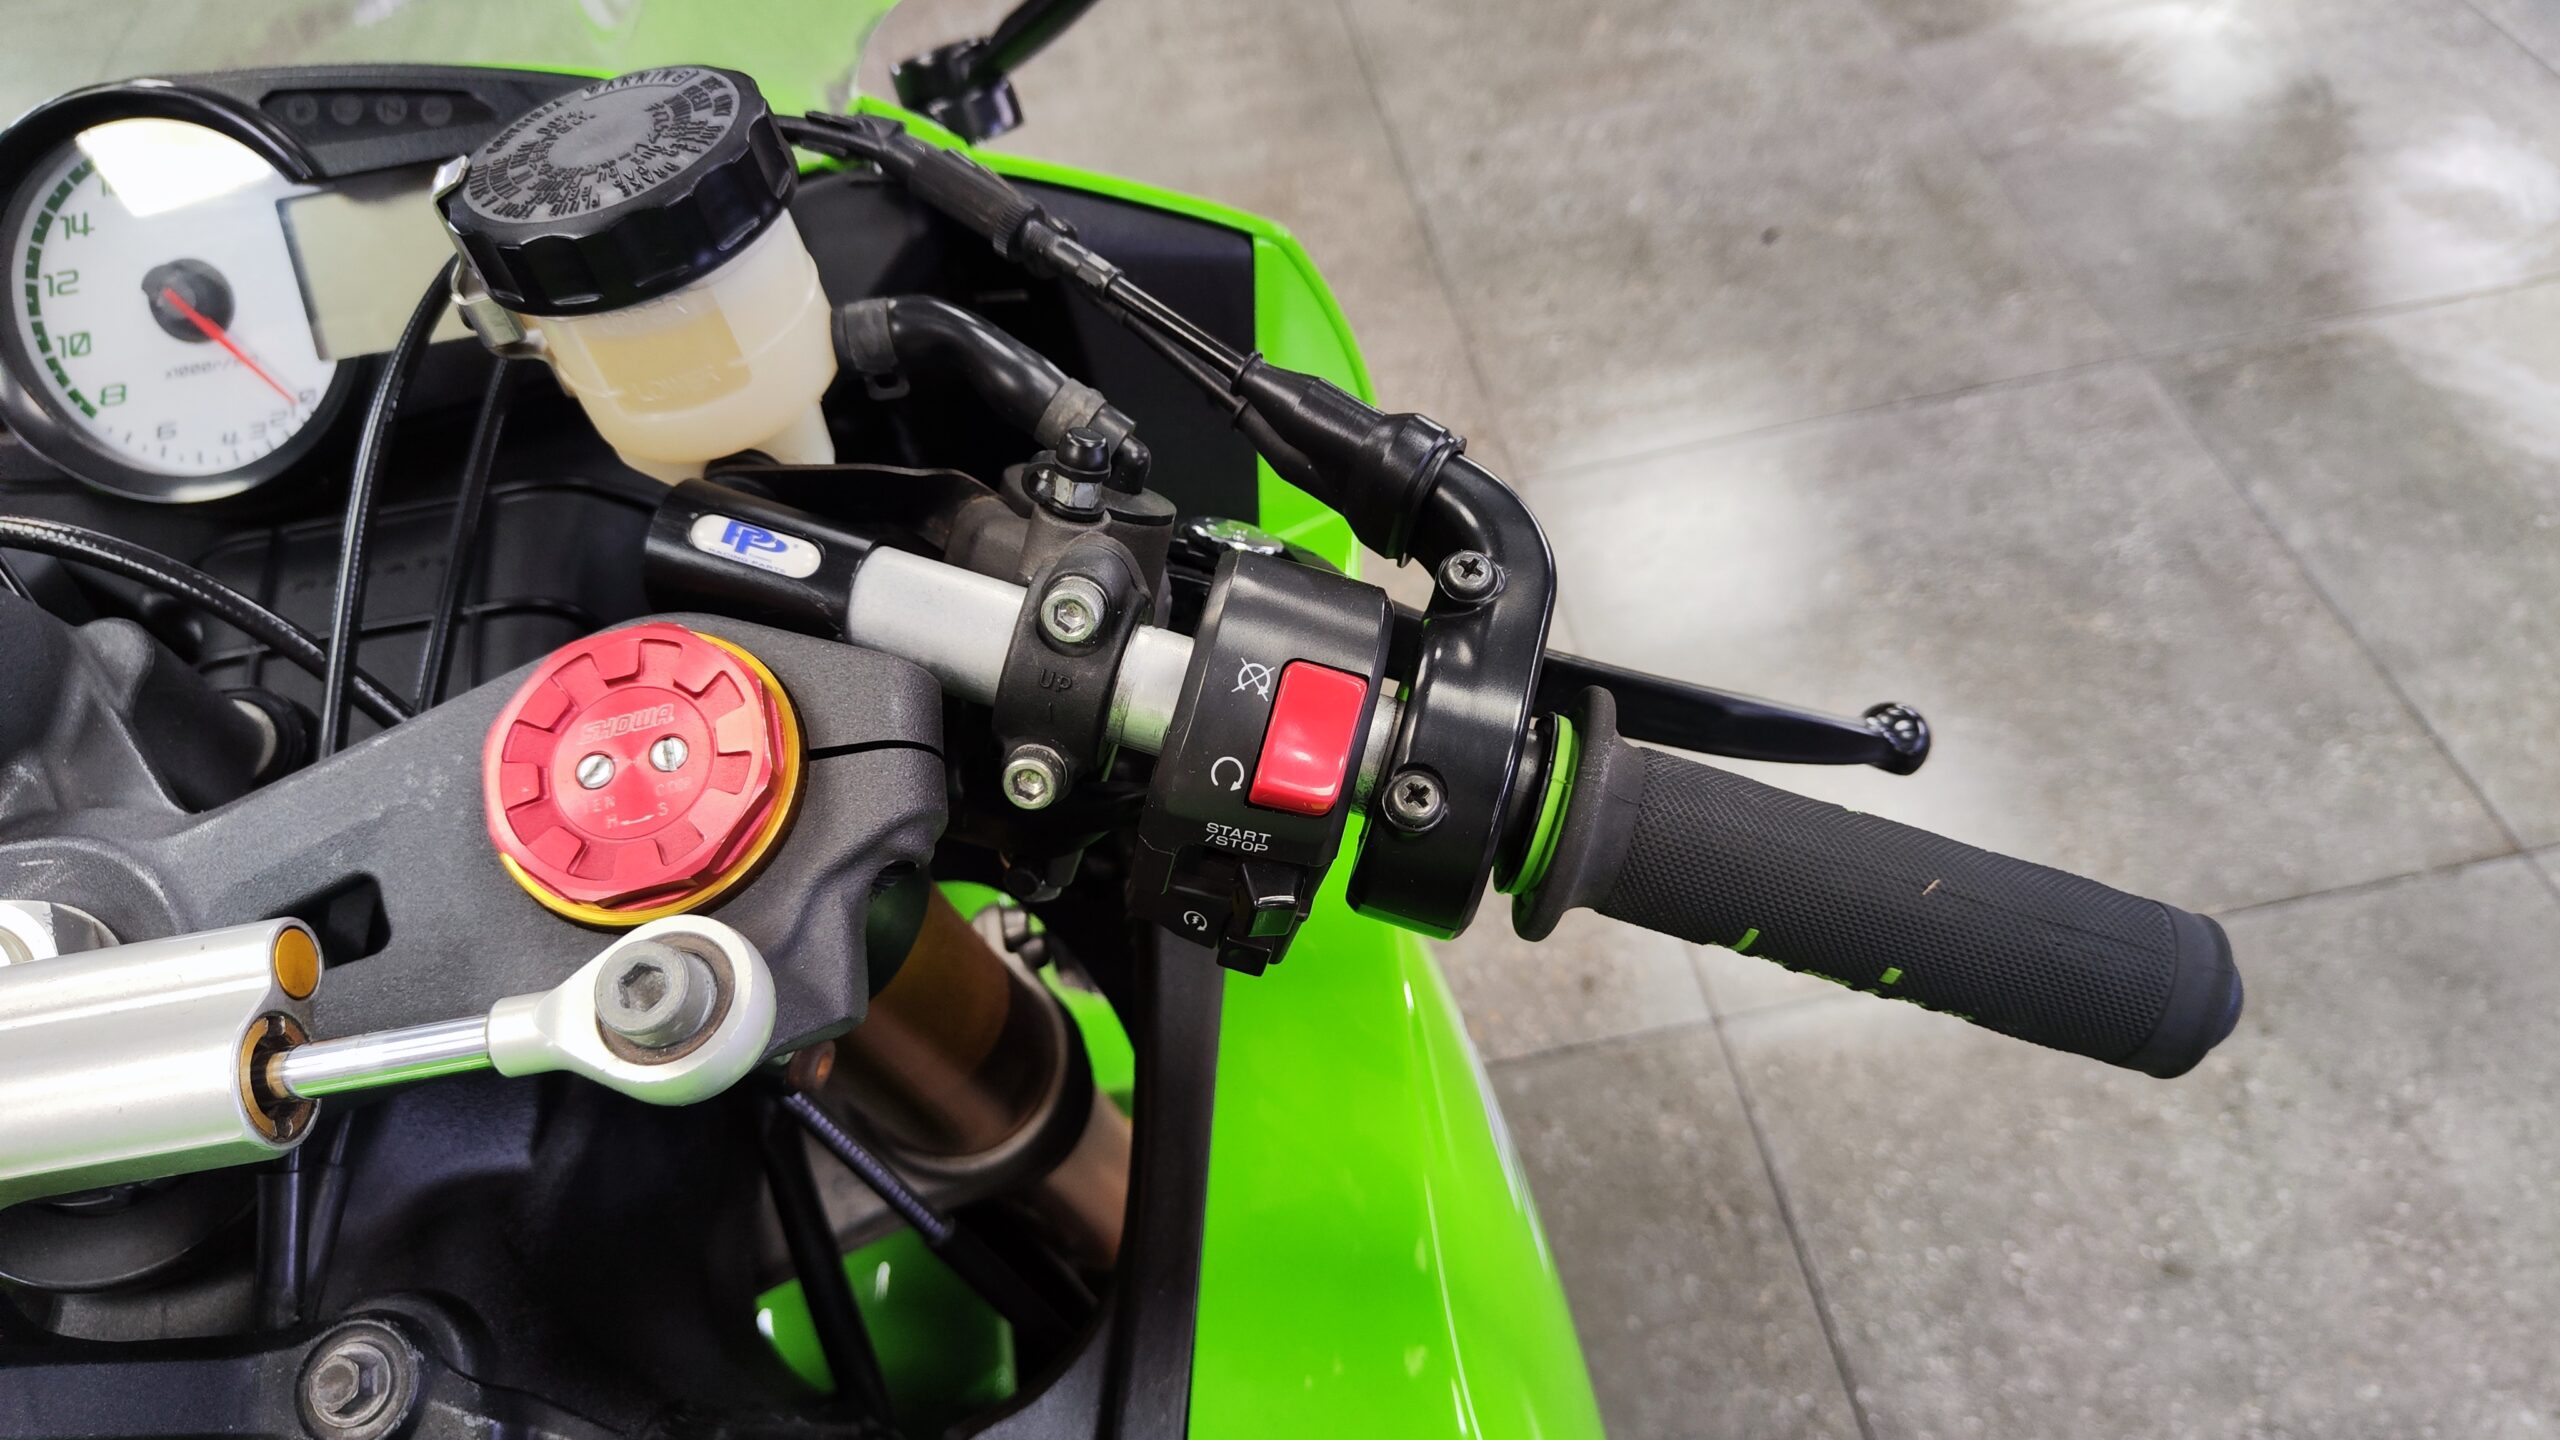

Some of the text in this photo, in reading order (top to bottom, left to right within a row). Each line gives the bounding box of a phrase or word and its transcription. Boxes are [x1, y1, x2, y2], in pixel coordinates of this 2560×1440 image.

[60, 212, 95, 240] 14
[44, 269, 79, 297] 12
[57, 332, 91, 359] 10
[100, 384, 127, 406] 8
[270, 410, 287, 427] 2
[157, 422, 177, 441] 6
[222, 431, 241, 446] 4
[250, 421, 267, 440] 3
[1040, 667, 1072, 692] UP
[576, 703, 675, 745] SHOWA
[657, 801, 669, 817] S
[1204, 834, 1269, 853] /STOP
[1205, 822, 1272, 844] START
